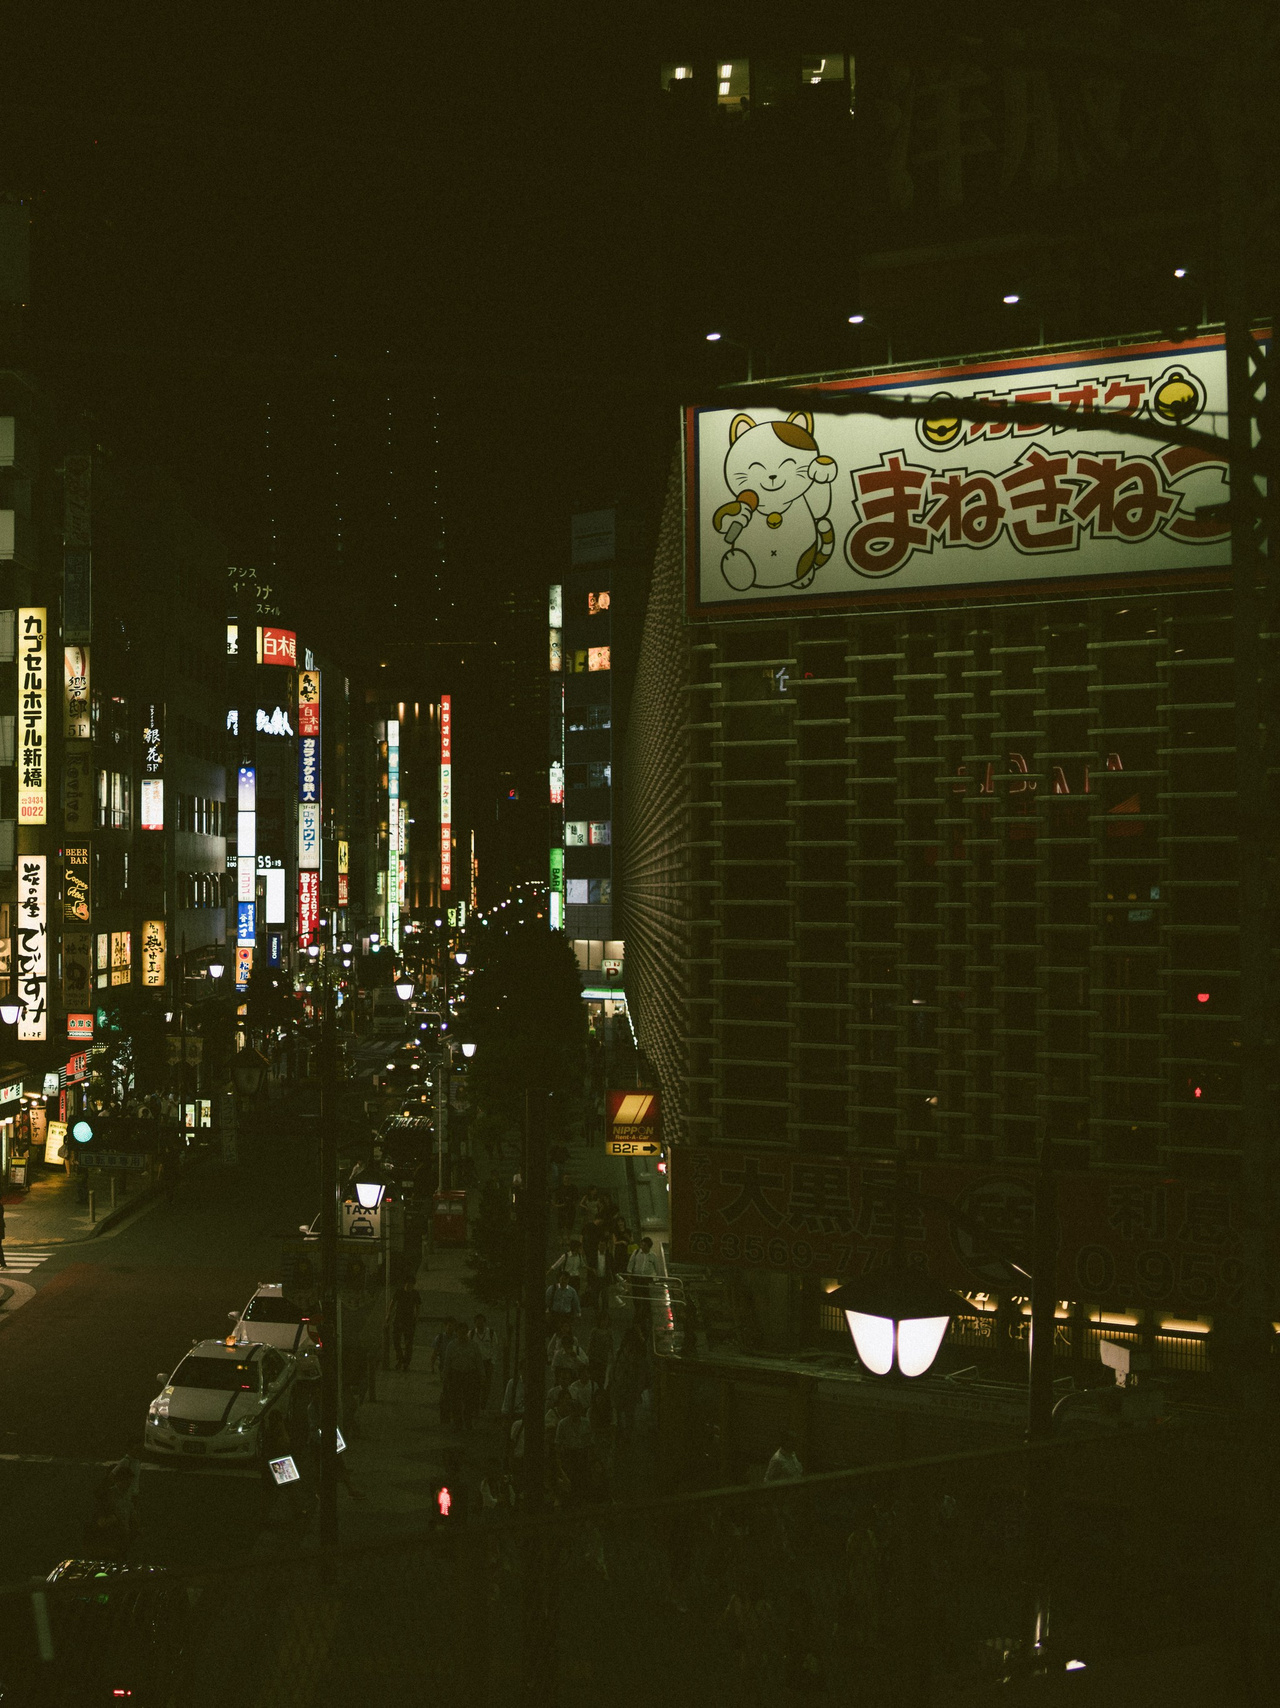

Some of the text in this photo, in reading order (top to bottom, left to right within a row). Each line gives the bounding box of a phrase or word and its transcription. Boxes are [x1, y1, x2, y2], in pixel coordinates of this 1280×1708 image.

[848, 448, 1232, 573] まねきねこ
[264, 631, 296, 659] 白木屋
[23, 615, 44, 788] カプセルホテル新橋
[68, 723, 87, 737] 5F
[146, 763, 159, 773] 5F
[302, 737, 316, 801] カラオケの鉄人
[28, 796, 44, 805] 3434
[21, 806, 44, 817] 0022
[303, 818, 316, 851] サウナ
[65, 849, 89, 857] BEER
[70, 857, 89, 865] BAR
[148, 975, 160, 984] 2F
[606, 968, 619, 981] P
[69, 1018, 94, 1029] 吉野家
[612, 1126, 654, 1135] NIPPON
[612, 1143, 639, 1154] B2F
[720, 1155, 928, 1241] 大黒屋
